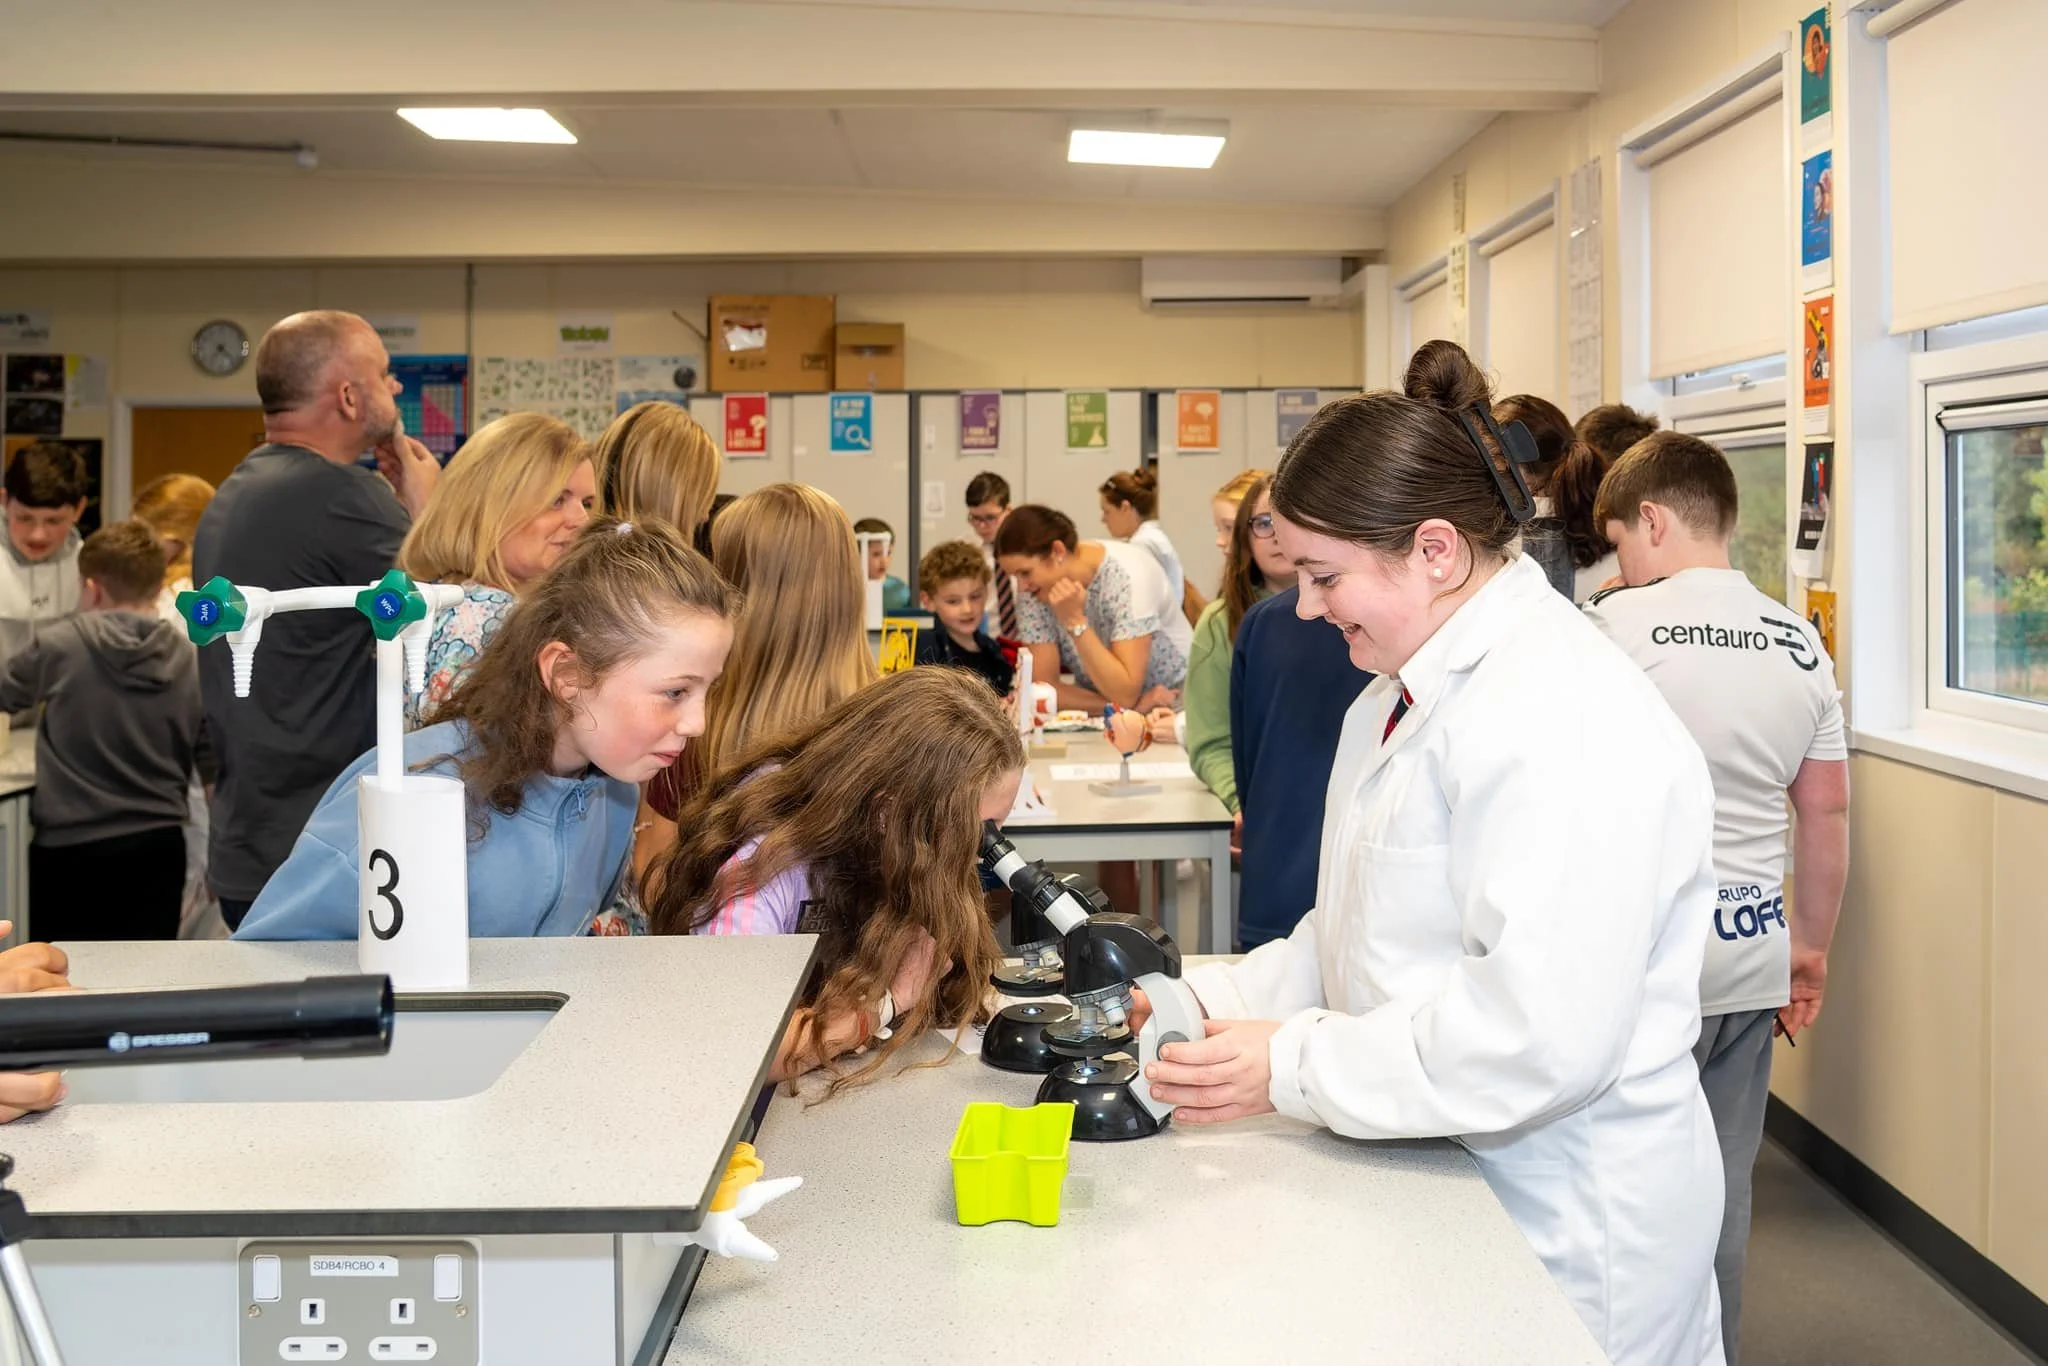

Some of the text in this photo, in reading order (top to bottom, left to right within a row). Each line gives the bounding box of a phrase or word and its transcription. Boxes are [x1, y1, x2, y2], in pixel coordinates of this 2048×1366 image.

[200, 603, 209, 621] WPC
[380, 597, 395, 616] WPC
[1651, 623, 1769, 651] centauro
[368, 848, 404, 941] 3
[1717, 885, 1762, 902] RUPO
[313, 1261, 385, 1270] SDB4/RCBO 4
